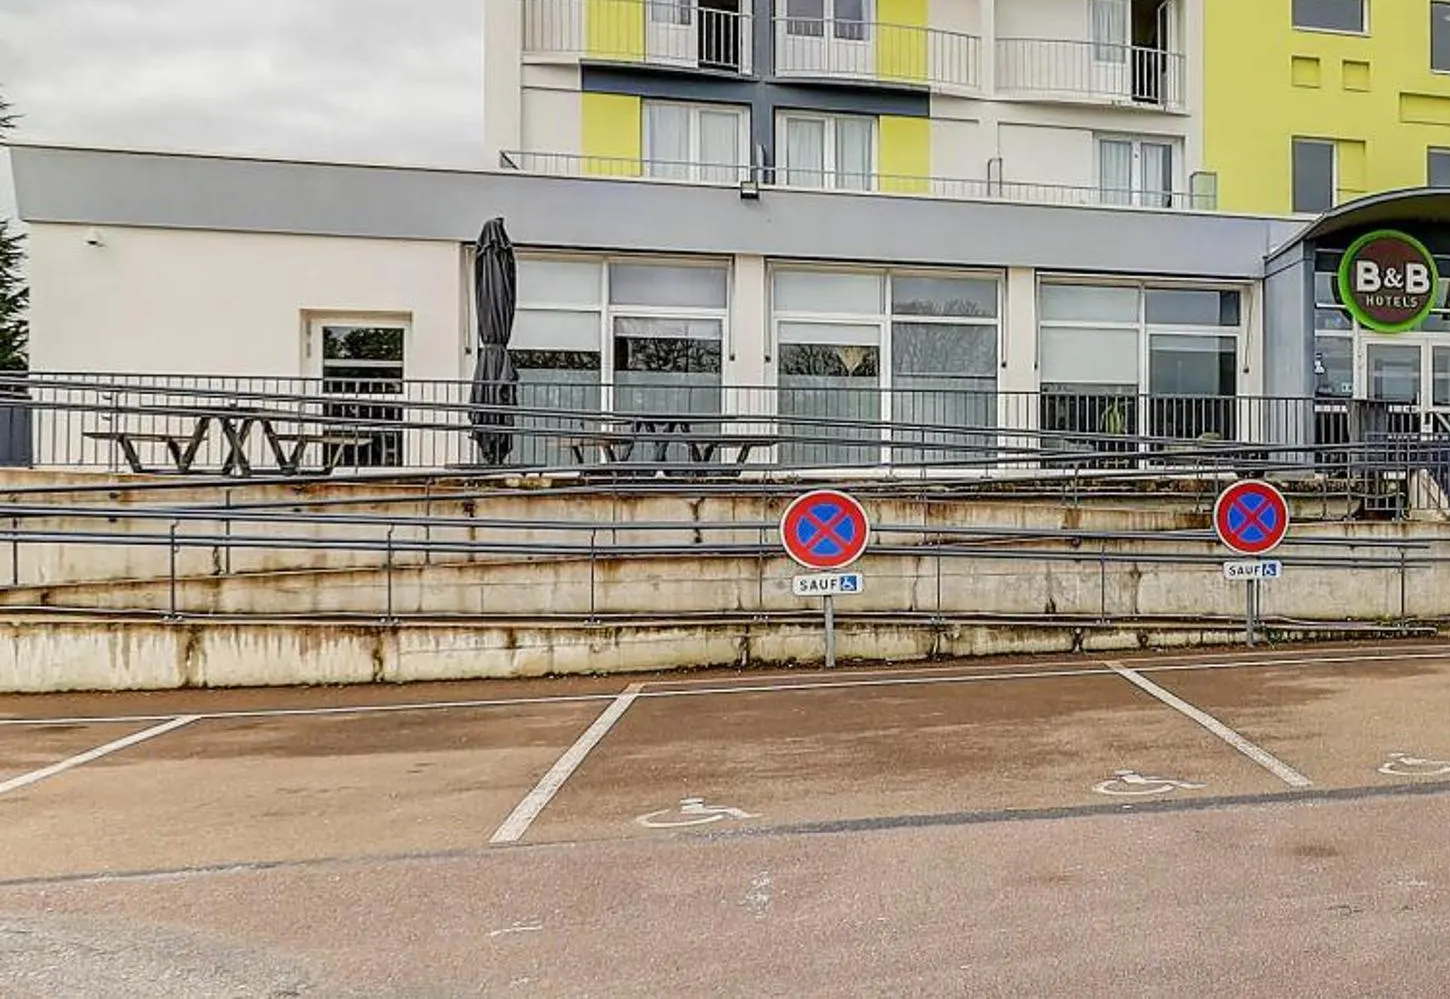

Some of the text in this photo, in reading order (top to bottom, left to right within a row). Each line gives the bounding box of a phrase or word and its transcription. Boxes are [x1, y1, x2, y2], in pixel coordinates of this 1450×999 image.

[1356, 260, 1430, 294] B&B
[1366, 295, 1418, 308] HOTELS
[1228, 566, 1261, 576] SAUF
[799, 578, 838, 591] SAUF
